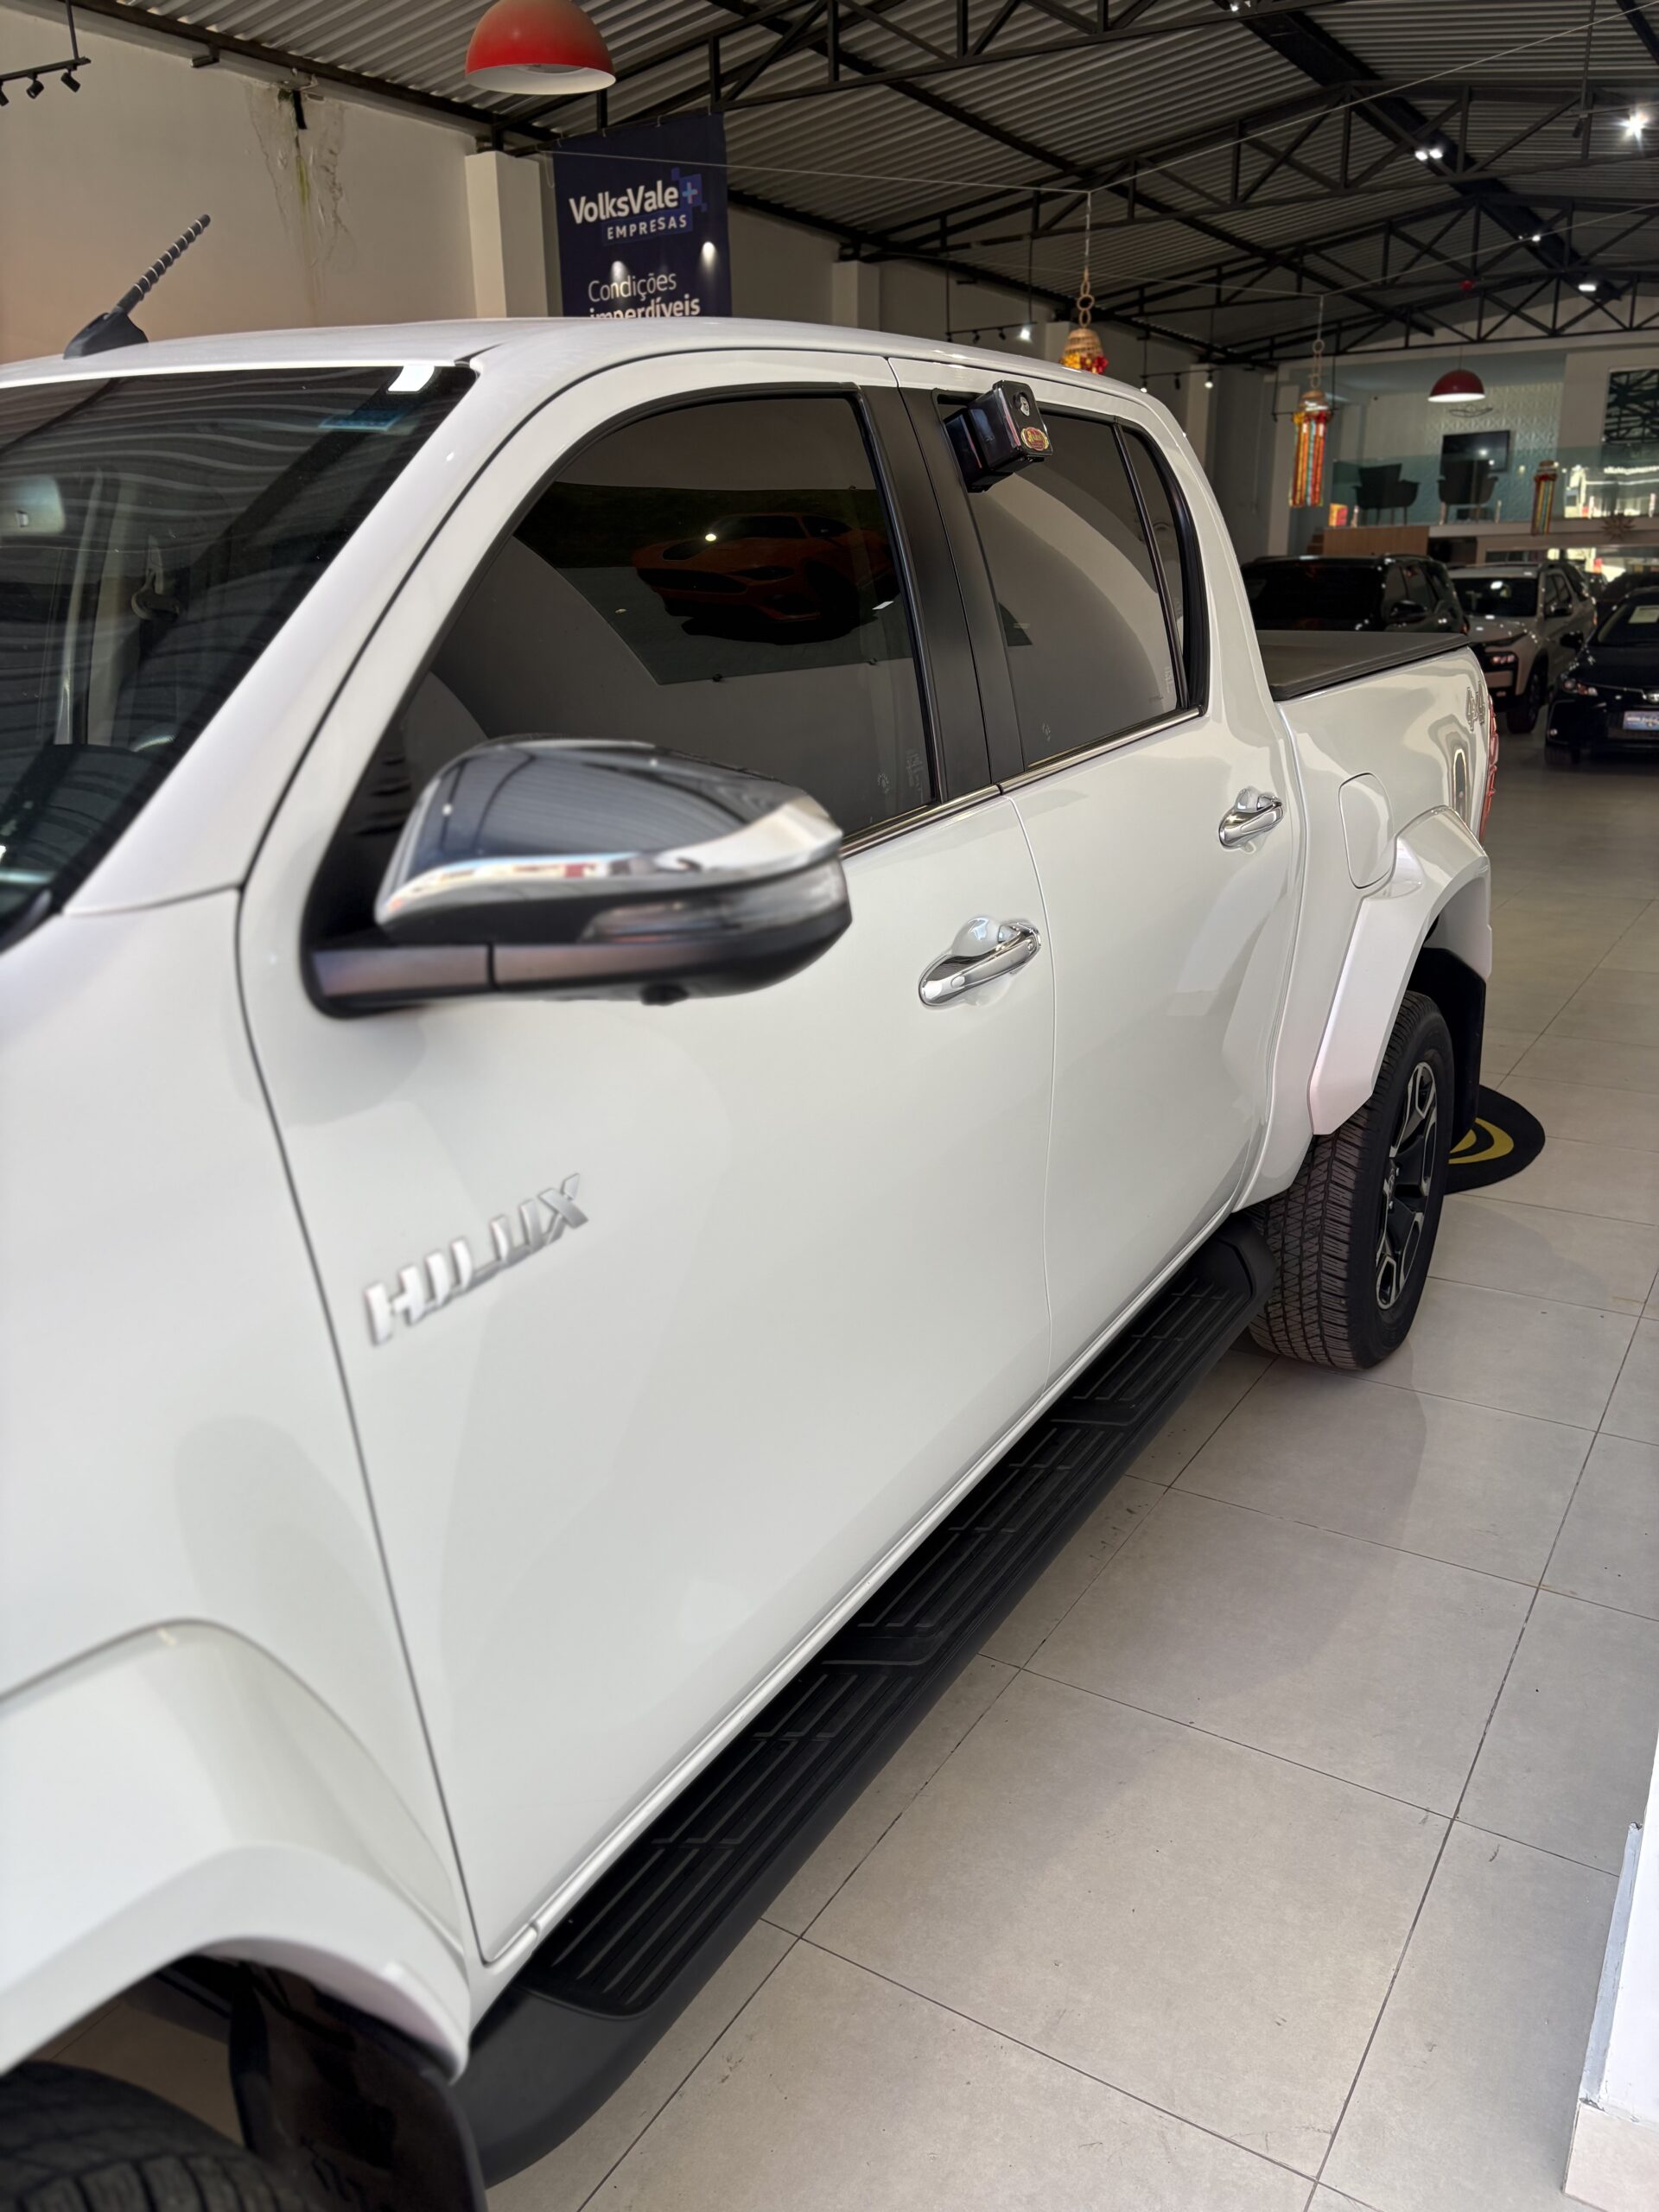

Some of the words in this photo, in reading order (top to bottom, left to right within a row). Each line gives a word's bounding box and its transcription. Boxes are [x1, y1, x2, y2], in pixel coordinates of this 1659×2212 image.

[607, 214, 688, 240] EMPRESAS
[588, 273, 677, 302] Condições
[363, 1172, 589, 1347] HILUX
